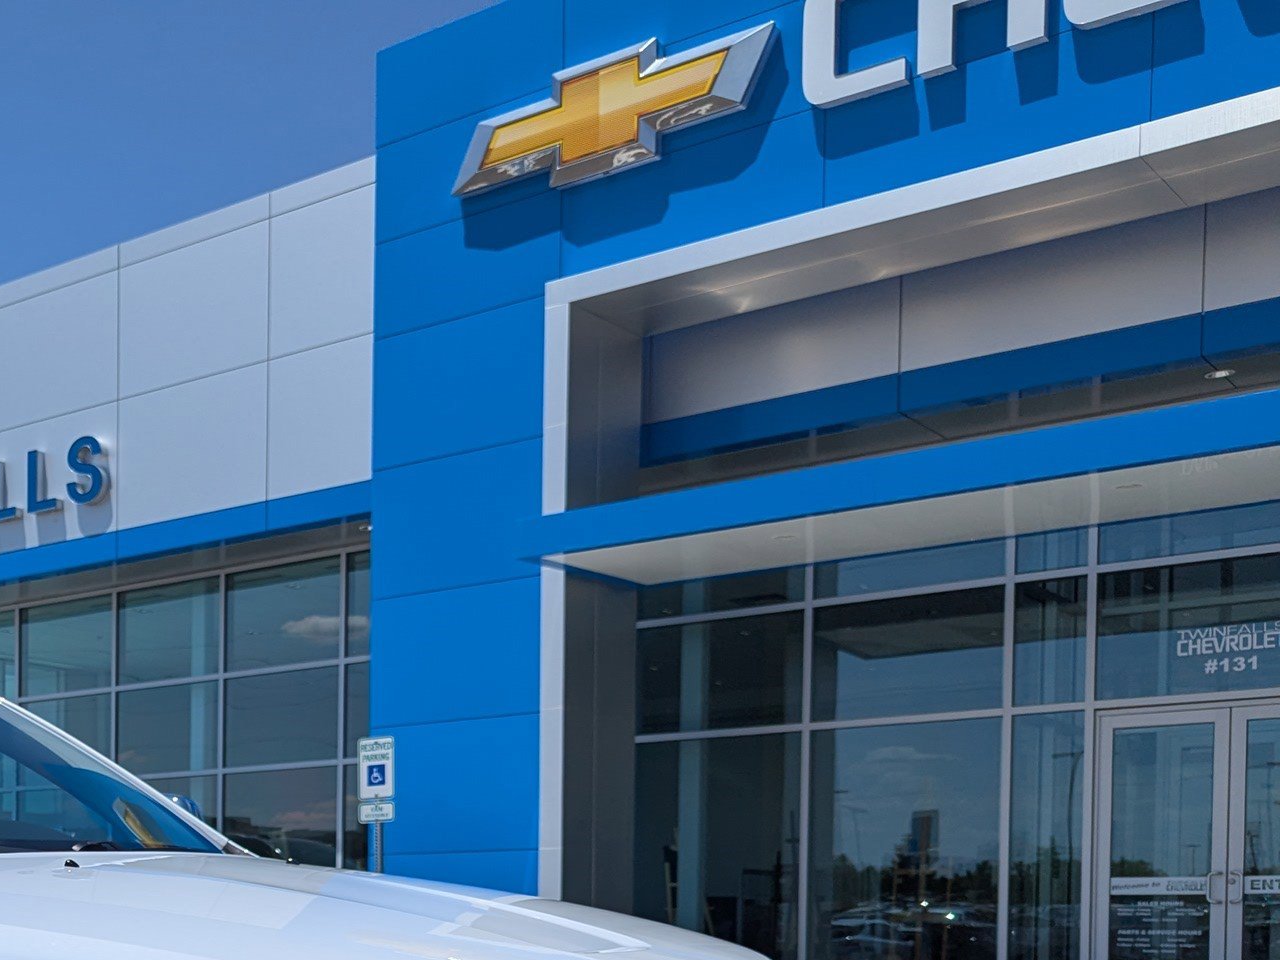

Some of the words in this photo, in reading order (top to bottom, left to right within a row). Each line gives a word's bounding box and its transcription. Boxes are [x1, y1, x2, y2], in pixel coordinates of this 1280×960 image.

[1204, 655, 1258, 674] #131
[360, 740, 392, 753] RESERVED
[362, 753, 390, 763] PARKING
